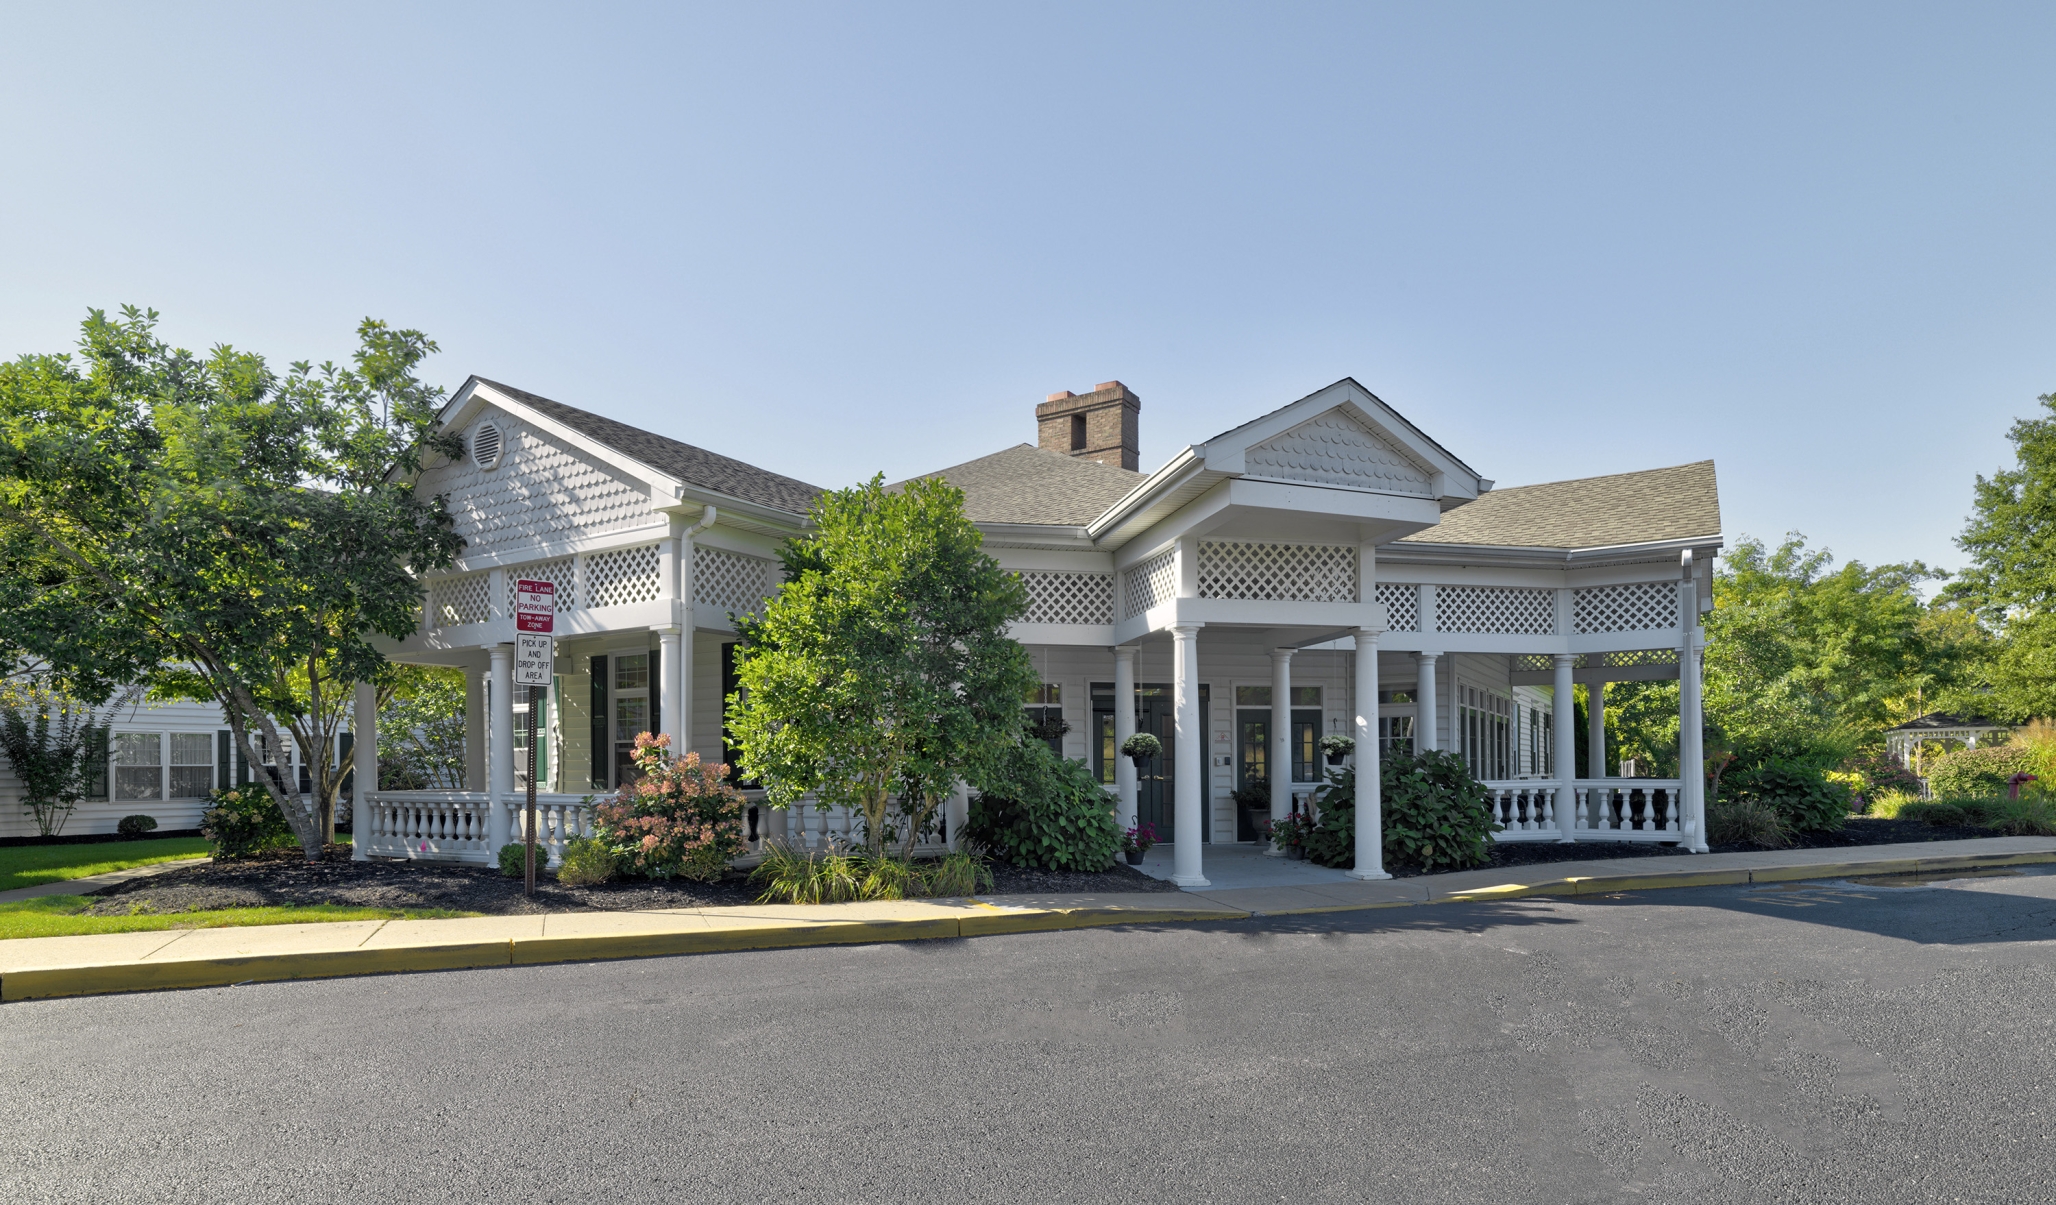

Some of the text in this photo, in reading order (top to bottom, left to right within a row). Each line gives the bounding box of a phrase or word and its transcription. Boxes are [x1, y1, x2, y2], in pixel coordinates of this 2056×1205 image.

[518, 584, 553, 594] FIRE LANE
[530, 594, 541, 602] NO
[518, 602, 552, 613] PARKING
[520, 614, 551, 622] TOW-AWAY
[522, 639, 547, 648] PICK UP
[528, 650, 541, 658] AND
[518, 660, 550, 669] DROP OFF
[525, 671, 543, 679] AREA
